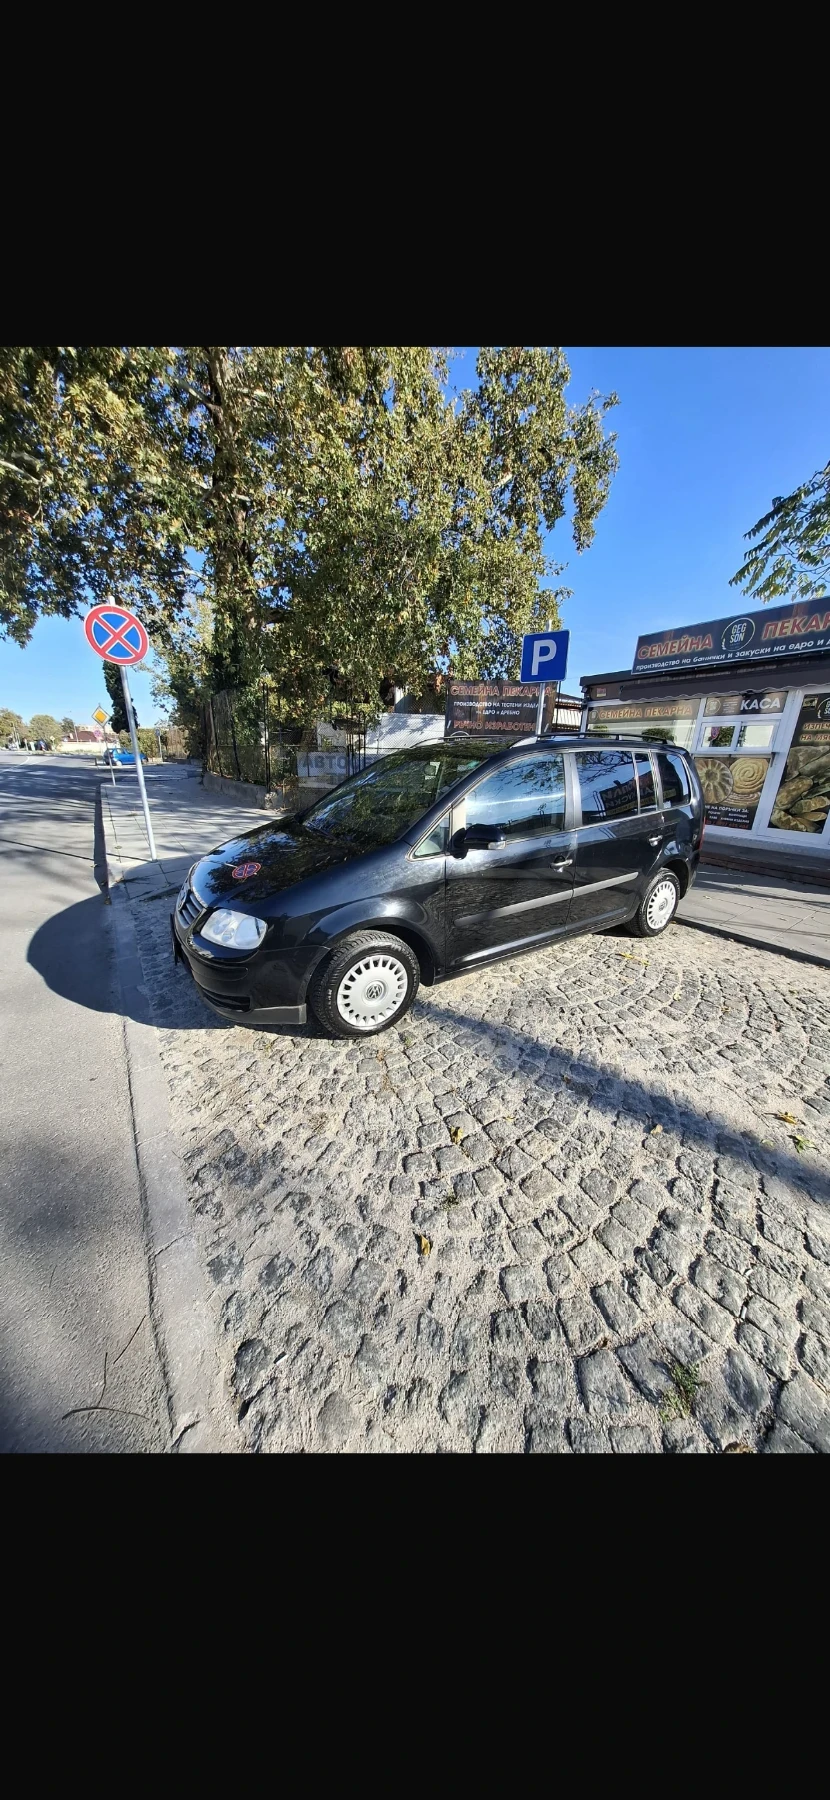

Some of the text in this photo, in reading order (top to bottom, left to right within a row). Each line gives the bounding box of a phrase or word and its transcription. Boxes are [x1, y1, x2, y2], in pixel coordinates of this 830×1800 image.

[731, 622, 747, 634] GEG
[729, 632, 745, 643] SON
[637, 633, 714, 660] СЕМЕЙНА
[531, 639, 557, 676] P
[636, 659, 680, 671] производство
[735, 646, 771, 657] закуски
[773, 644, 786, 652] на
[788, 640, 814, 650] едро
[450, 684, 500, 696] СЕМЕЙНА
[740, 697, 781, 711] КАСА
[599, 707, 643, 719] СЕМЕЙНА
[644, 705, 693, 718] ПЕКАРНА
[453, 720, 484, 730] РЪЧНО
